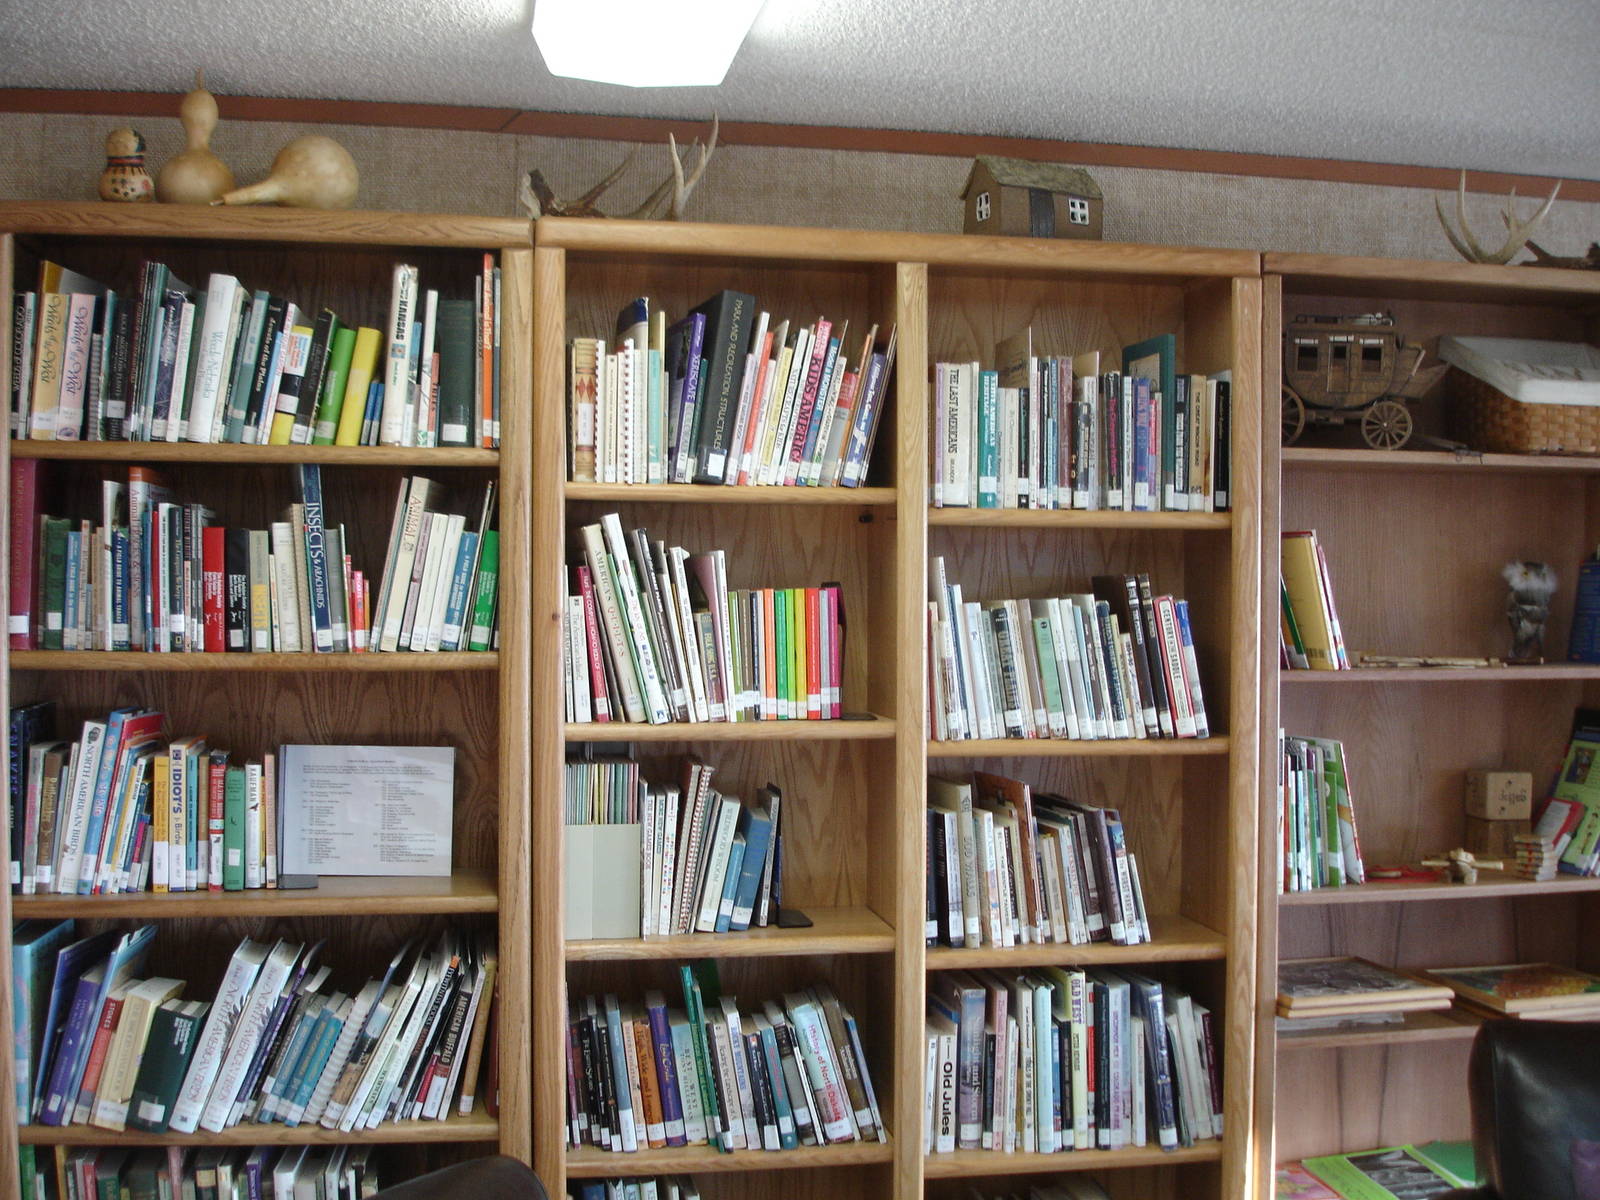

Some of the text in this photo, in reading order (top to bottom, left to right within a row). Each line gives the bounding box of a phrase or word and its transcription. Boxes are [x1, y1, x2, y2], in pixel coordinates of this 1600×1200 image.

[484, 269, 492, 293] What
[396, 300, 408, 340] KANSAS
[255, 317, 276, 392] Jewels of the Plains
[825, 346, 837, 367] Model
[66, 361, 83, 395] West
[687, 353, 700, 401] XERISCAPE
[713, 300, 743, 450] PARK AND RECREATION STRUCTURES
[816, 373, 830, 410] MONSTER
[950, 369, 959, 385] THE
[782, 395, 792, 423] CRAFTS
[949, 385, 959, 406] LAST
[947, 406, 959, 454] AMERICANS
[131, 489, 141, 522] Animal
[307, 502, 324, 558] INSECTS
[314, 565, 325, 608] ARACHNIDS
[594, 550, 612, 602] AMERICA'S
[253, 584, 267, 628] INSECTS
[654, 591, 662, 613] PLAINS
[1163, 609, 1181, 680] CENTURY SADDLE
[82, 745, 95, 778] NORTH
[74, 779, 89, 826] AMERICAN
[172, 768, 182, 813] IDIOT'S
[249, 767, 258, 802] KAUFMAN
[69, 829, 81, 855] BIRDS
[712, 807, 733, 882] WILDWOOD WISDOM
[1121, 871, 1130, 892] WORST
[1124, 895, 1133, 912] HARD
[1127, 914, 1135, 928] TIME
[215, 983, 238, 1022] NORTH
[248, 984, 272, 1025] NORTH
[432, 967, 456, 1005] EYEWITNESS
[1071, 979, 1081, 996] OLD
[102, 1002, 116, 1029] STOKES
[425, 1005, 439, 1026] BOOKS
[441, 995, 468, 1064] AMERICAN BUFFALO
[1072, 998, 1082, 1025] WEST
[195, 1024, 228, 1073] AMERICAN
[229, 1026, 260, 1072] AMERICAN
[639, 1054, 649, 1075] Wide
[731, 1026, 746, 1090] ROCKY MOUNTAINS
[643, 1077, 651, 1092] and
[809, 1024, 841, 1122] History of North Dakota
[970, 1017, 981, 1121] Sunlight and Storm
[689, 1084, 698, 1109] WEST
[722, 1080, 735, 1107] Landscape
[941, 1062, 953, 1136] Old Jules
